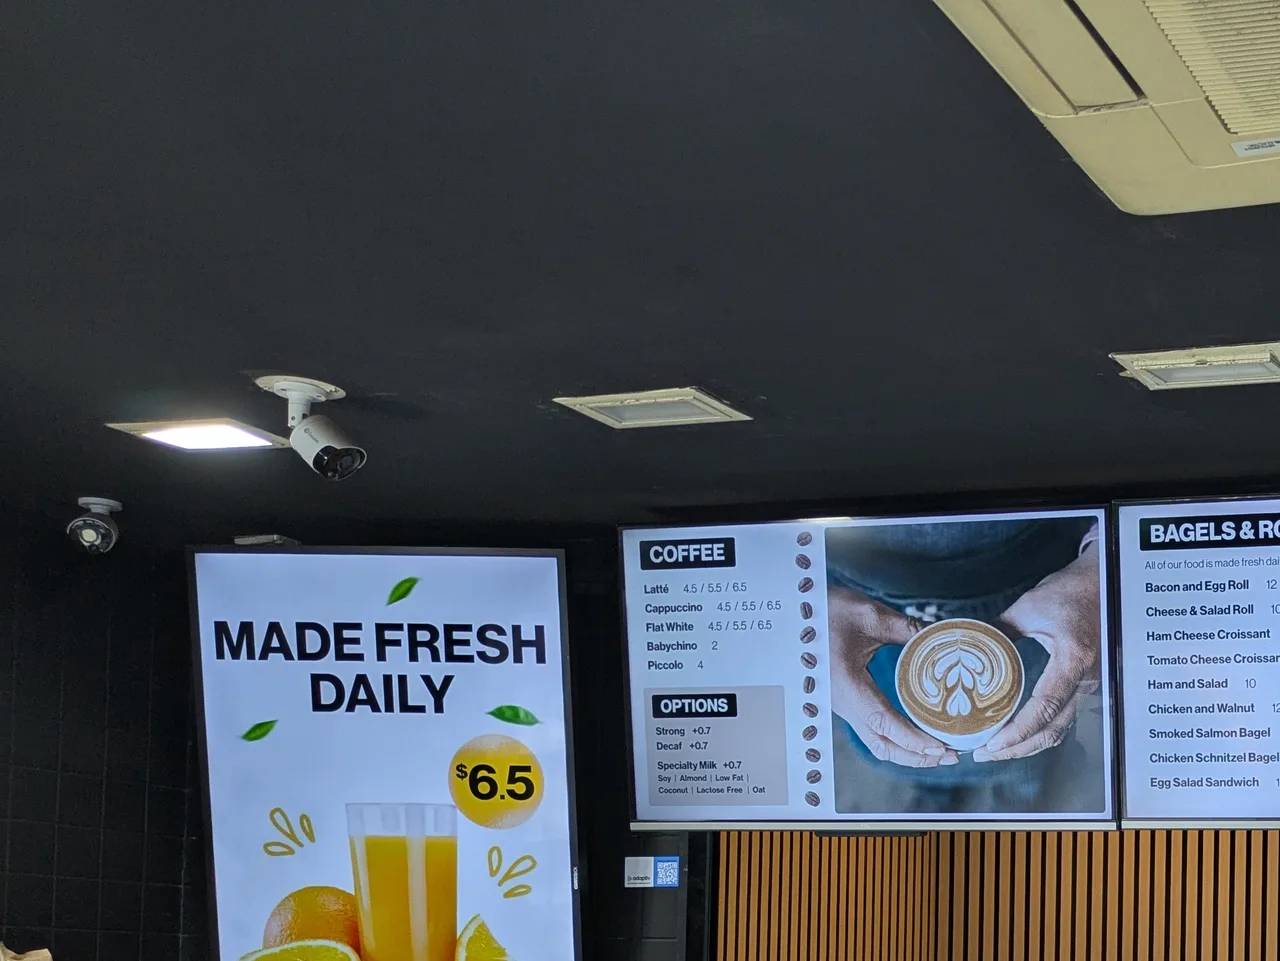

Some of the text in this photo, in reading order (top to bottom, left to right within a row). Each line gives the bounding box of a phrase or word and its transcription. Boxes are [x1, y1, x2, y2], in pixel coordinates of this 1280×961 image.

[1151, 522, 1236, 542] BAGELS
[1240, 521, 1255, 539] &
[650, 544, 725, 562] COFFEE
[1145, 561, 1155, 570] All
[1157, 560, 1166, 569] of
[1184, 560, 1204, 568] food
[1206, 559, 1213, 568] is
[1215, 558, 1240, 567] made
[1242, 557, 1264, 566] fresh
[644, 582, 746, 594] Latté 4.5 5.5 6.5
[1146, 580, 1277, 592] Bacon and Egg Roll 12
[645, 601, 781, 614] Cappuccino 4.5 5.5 6.5
[1146, 607, 1187, 616] Cheese
[1190, 606, 1197, 615] &
[1200, 605, 1230, 615] Salad
[1233, 604, 1253, 614] Roll
[646, 620, 772, 632] Flat White 4.5 5.5 6.5
[1147, 632, 1172, 641] Ham
[1174, 631, 1215, 640] Cheese
[1218, 629, 1270, 639] Croissant
[214, 621, 546, 664] MADE FRESH
[647, 641, 717, 652] Babychino 2
[648, 660, 703, 670] Piccolo 4
[310, 674, 454, 713] DAILY
[661, 698, 728, 713] OPTIONS
[656, 727, 685, 736] Strong
[657, 742, 682, 750] Decaf
[658, 761, 741, 771] Specialty Milk +0.7
[456, 763, 534, 801] $6.5
[658, 775, 671, 783] Soy
[1150, 778, 1170, 789] Egg
[1173, 778, 1203, 787] Salad
[1206, 777, 1259, 787] Sandwich
